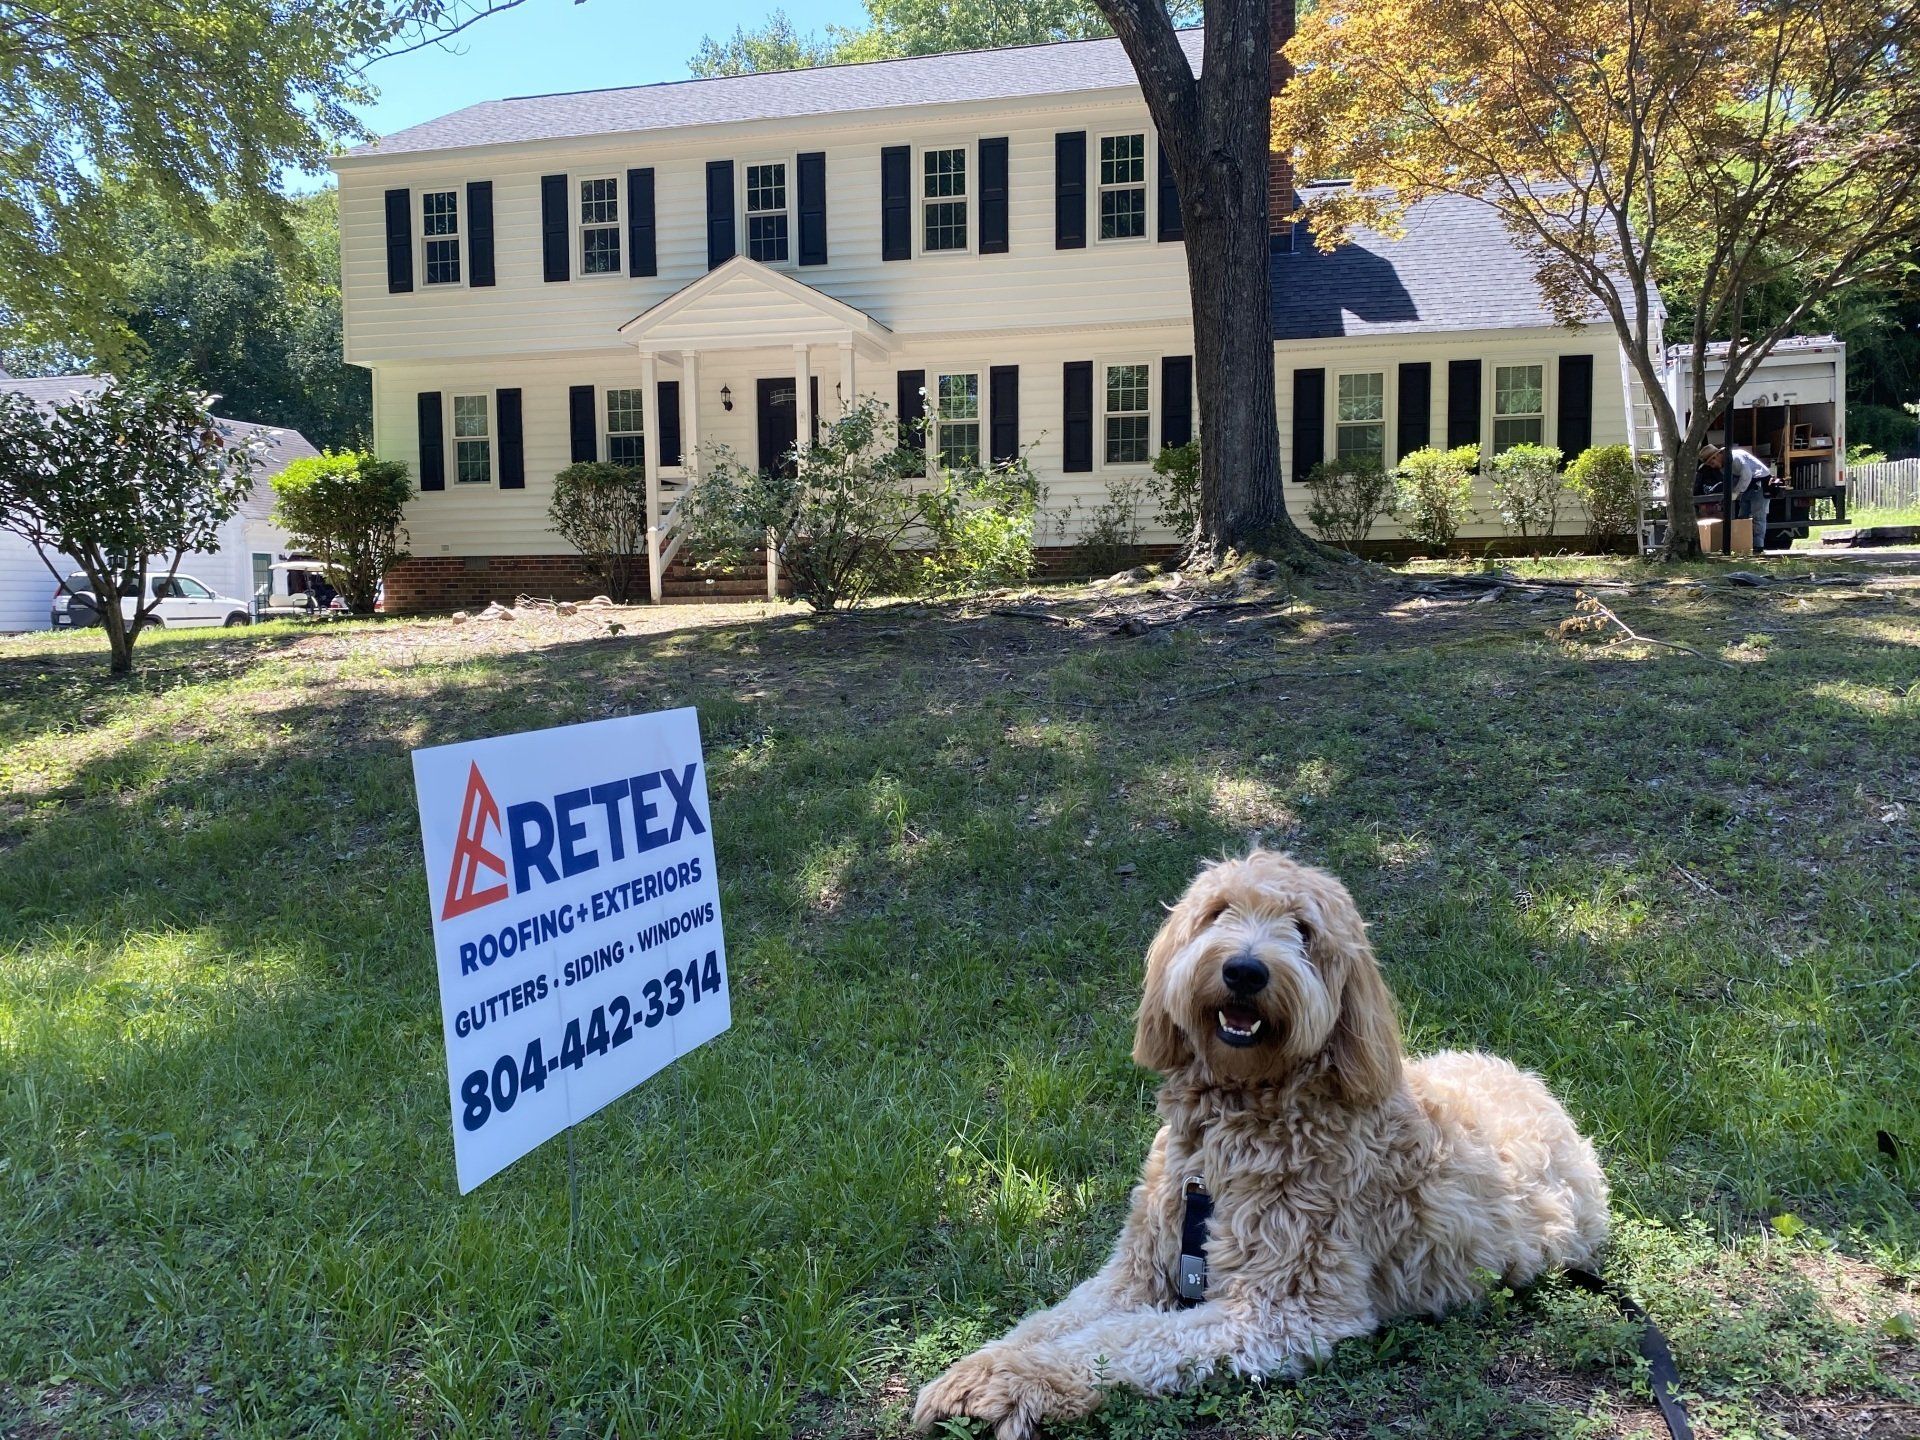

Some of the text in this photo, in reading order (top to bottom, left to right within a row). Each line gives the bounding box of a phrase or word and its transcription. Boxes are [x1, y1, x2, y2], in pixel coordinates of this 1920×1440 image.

[455, 902, 715, 1038] GUTTERS SIDING WINDOWS
[460, 949, 722, 1132] 804-442-3314
